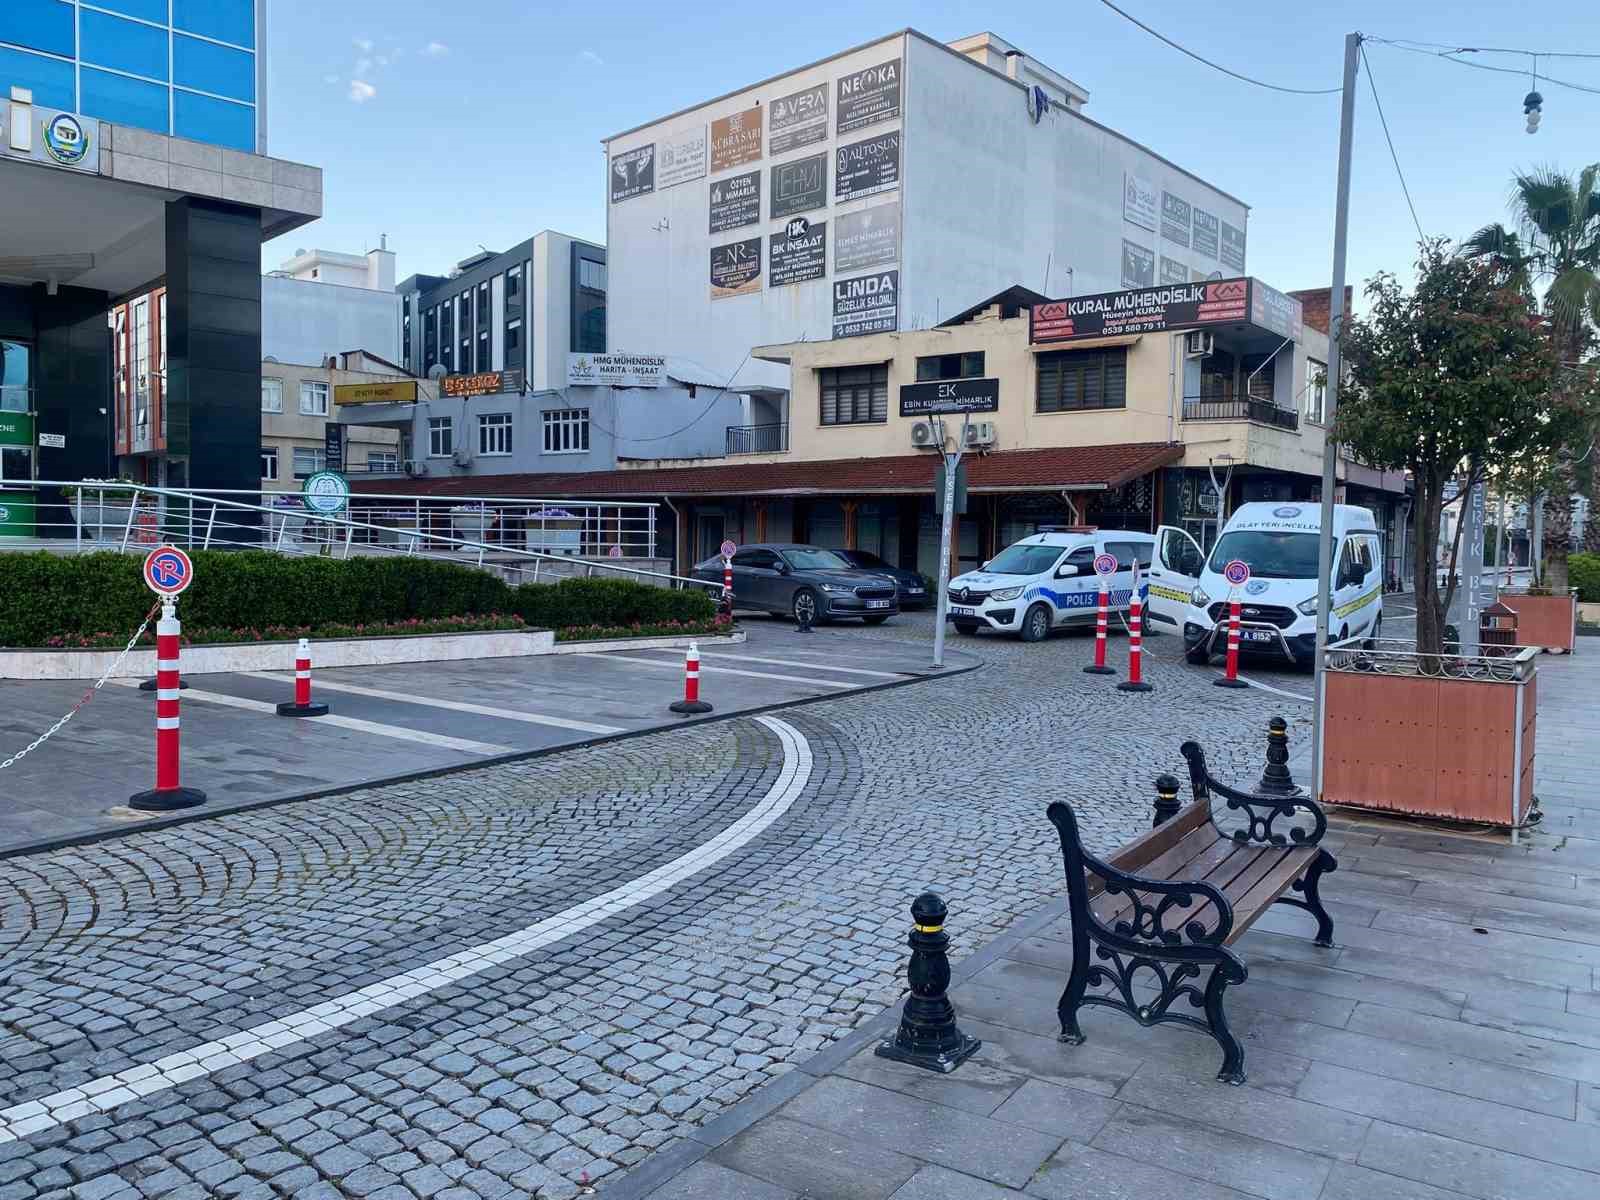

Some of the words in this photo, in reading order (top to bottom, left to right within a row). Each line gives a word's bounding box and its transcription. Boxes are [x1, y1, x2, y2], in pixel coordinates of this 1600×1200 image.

[788, 90, 825, 114] VERA
[788, 220, 806, 236] BK
[727, 243, 746, 264] NR
[772, 243, 785, 255] BK
[1068, 300, 1110, 316] KURAL
[1114, 284, 1204, 313] MÜHENDİSLİK
[1135, 305, 1166, 316] KURAL
[1102, 325, 1123, 335] 0539
[1156, 320, 1166, 329] 11
[593, 356, 612, 365] HMG
[600, 365, 626, 374] HARİTA
[633, 366, 659, 376] İNŞAAT
[938, 384, 957, 397] EK
[956, 396, 992, 405] MİMARLIK
[1467, 575, 1480, 621] BLD
[1252, 632, 1271, 641] 8152
